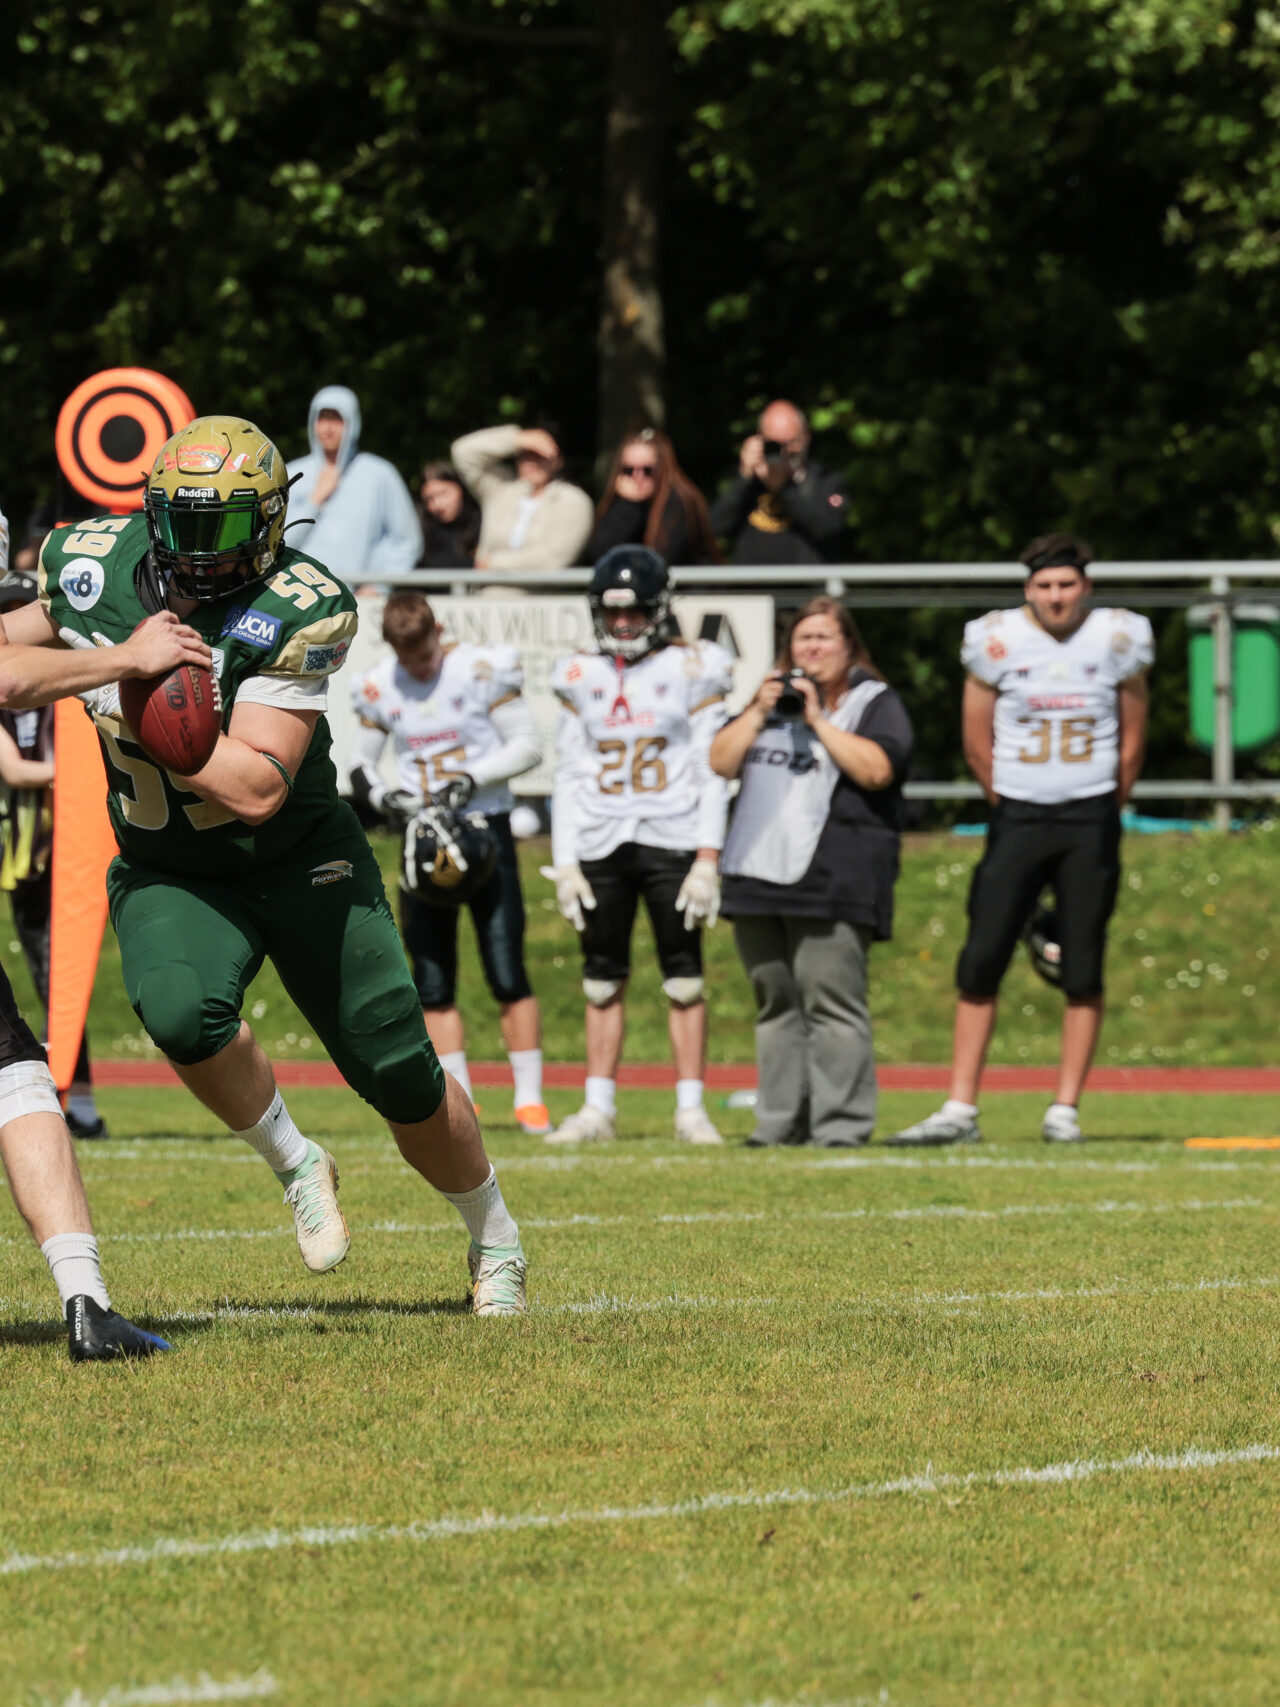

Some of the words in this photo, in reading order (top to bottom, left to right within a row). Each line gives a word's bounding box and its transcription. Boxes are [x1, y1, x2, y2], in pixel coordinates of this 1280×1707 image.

[177, 487, 215, 499] Riddell
[62, 518, 132, 557] 59
[264, 562, 341, 610] 59
[1017, 716, 1097, 764] 36
[597, 736, 668, 795] 26
